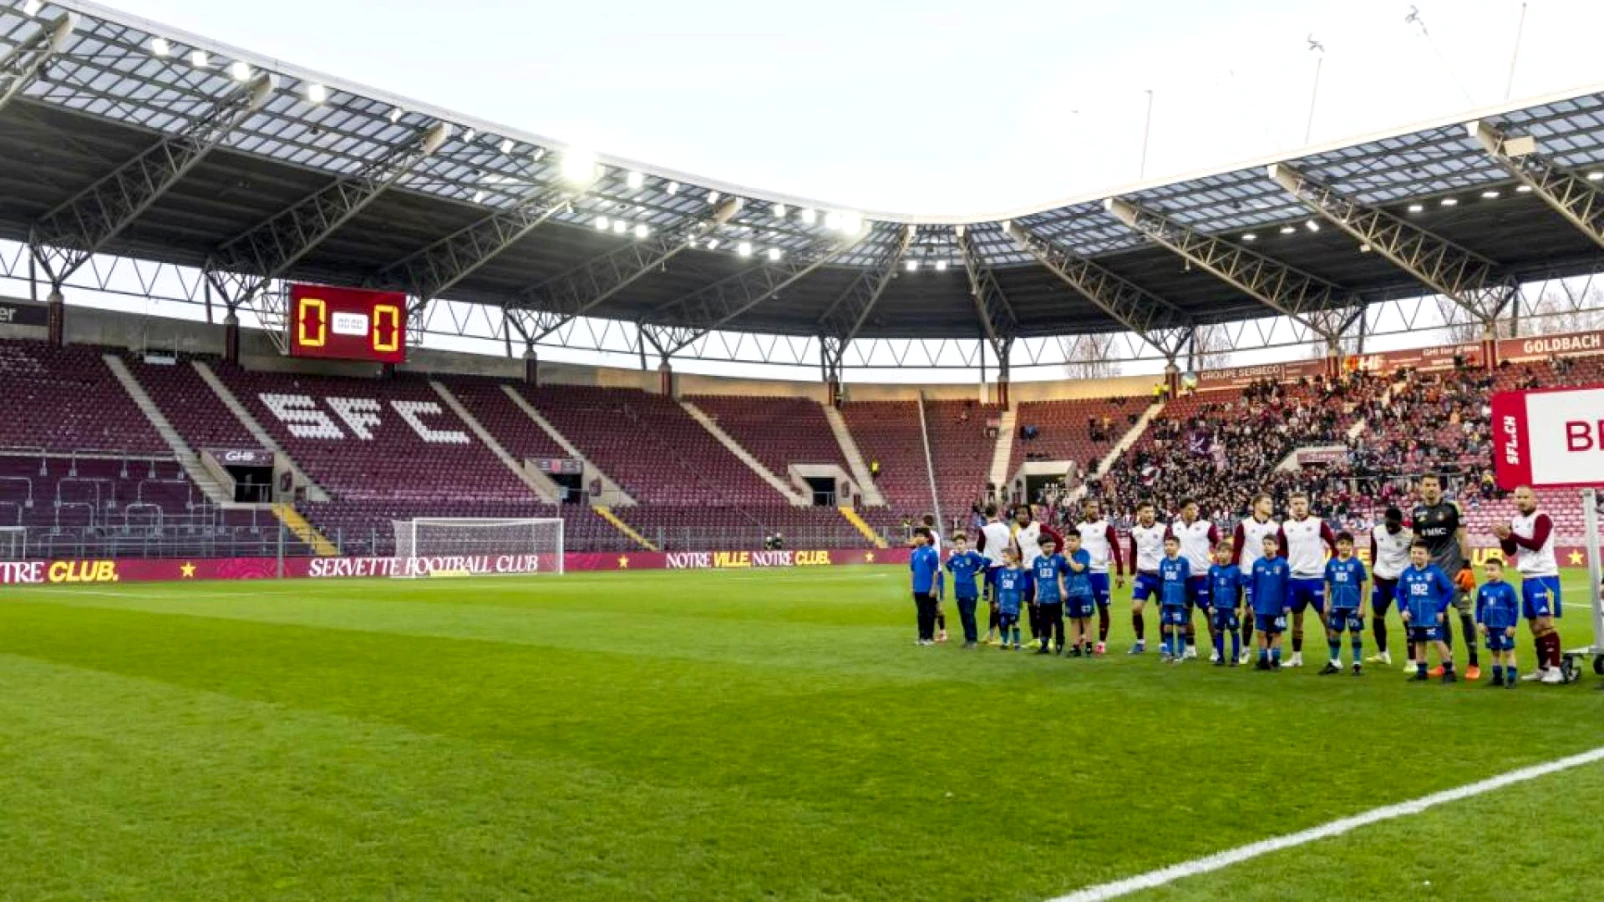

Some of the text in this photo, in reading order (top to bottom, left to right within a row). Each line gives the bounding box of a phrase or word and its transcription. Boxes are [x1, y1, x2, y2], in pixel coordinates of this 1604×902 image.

[299, 298, 326, 347] 0
[373, 304, 399, 352] 0
[1523, 333, 1600, 354] GOLDBACH
[1200, 369, 1236, 381] GROUPE
[1503, 415, 1519, 466] SFL.CH
[48, 560, 119, 583] CLUB.
[308, 554, 539, 578] SERVETTE FOOTBALL CLUB
[665, 552, 712, 569] NOTRE
[752, 551, 794, 567] NOTRE
